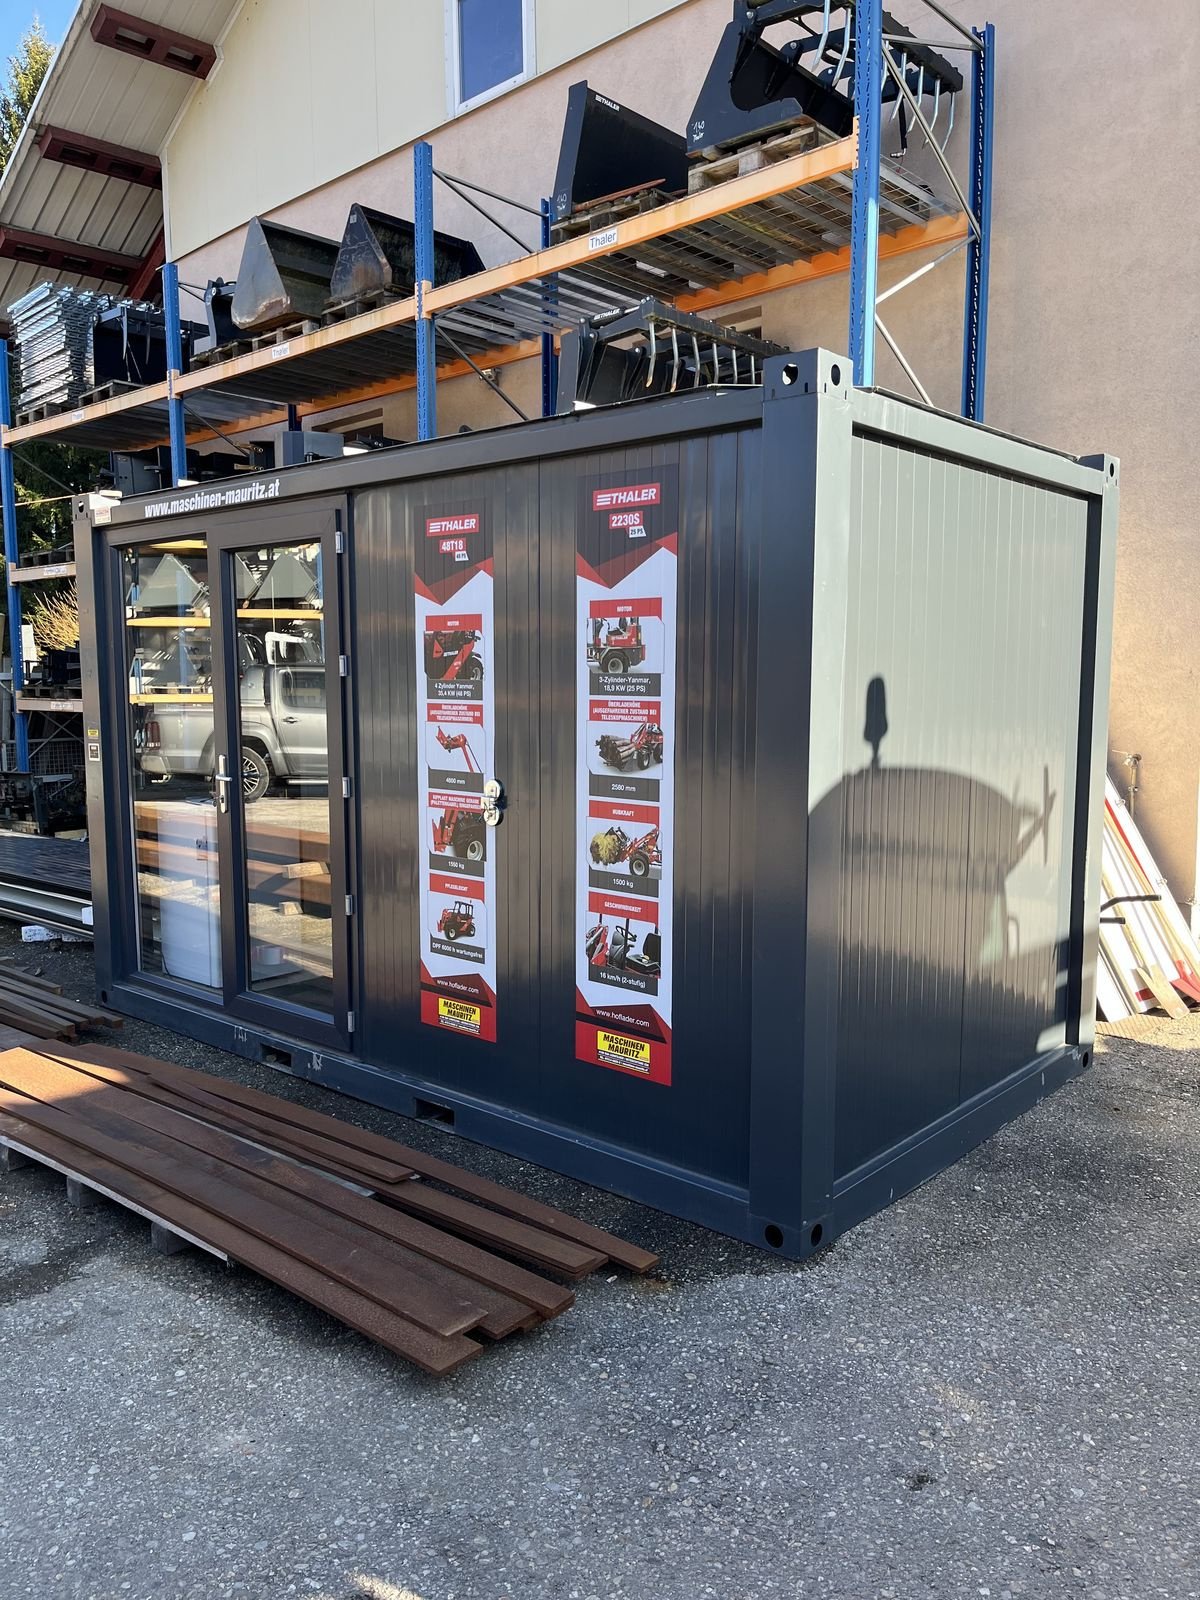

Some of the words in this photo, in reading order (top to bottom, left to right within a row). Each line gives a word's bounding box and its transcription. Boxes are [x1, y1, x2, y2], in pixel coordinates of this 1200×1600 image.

[590, 232, 617, 249] Thaler
[272, 346, 289, 358] Thaler
[144, 478, 280, 518] www.maschinen-mauritz.at
[611, 488, 657, 504] THALER
[440, 518, 477, 532] THALER
[611, 512, 640, 527] 2230S
[441, 540, 464, 551] 48T18
[598, 676, 651, 684] 3-Zylinder-Yanmar,
[636, 685, 646, 693] PS)
[458, 862, 465, 870] kg
[626, 880, 634, 889] kg
[436, 978, 480, 995] www.hoflader.com
[607, 973, 621, 982] km/h
[621, 976, 646, 989] (2-stufig)
[442, 999, 477, 1016] MASCHINEN
[446, 1008, 473, 1021] MAURITZ
[595, 1008, 650, 1028] www.hoflader.com
[602, 1033, 646, 1052] MASCHINEN
[607, 1043, 640, 1059] MAURITZ
